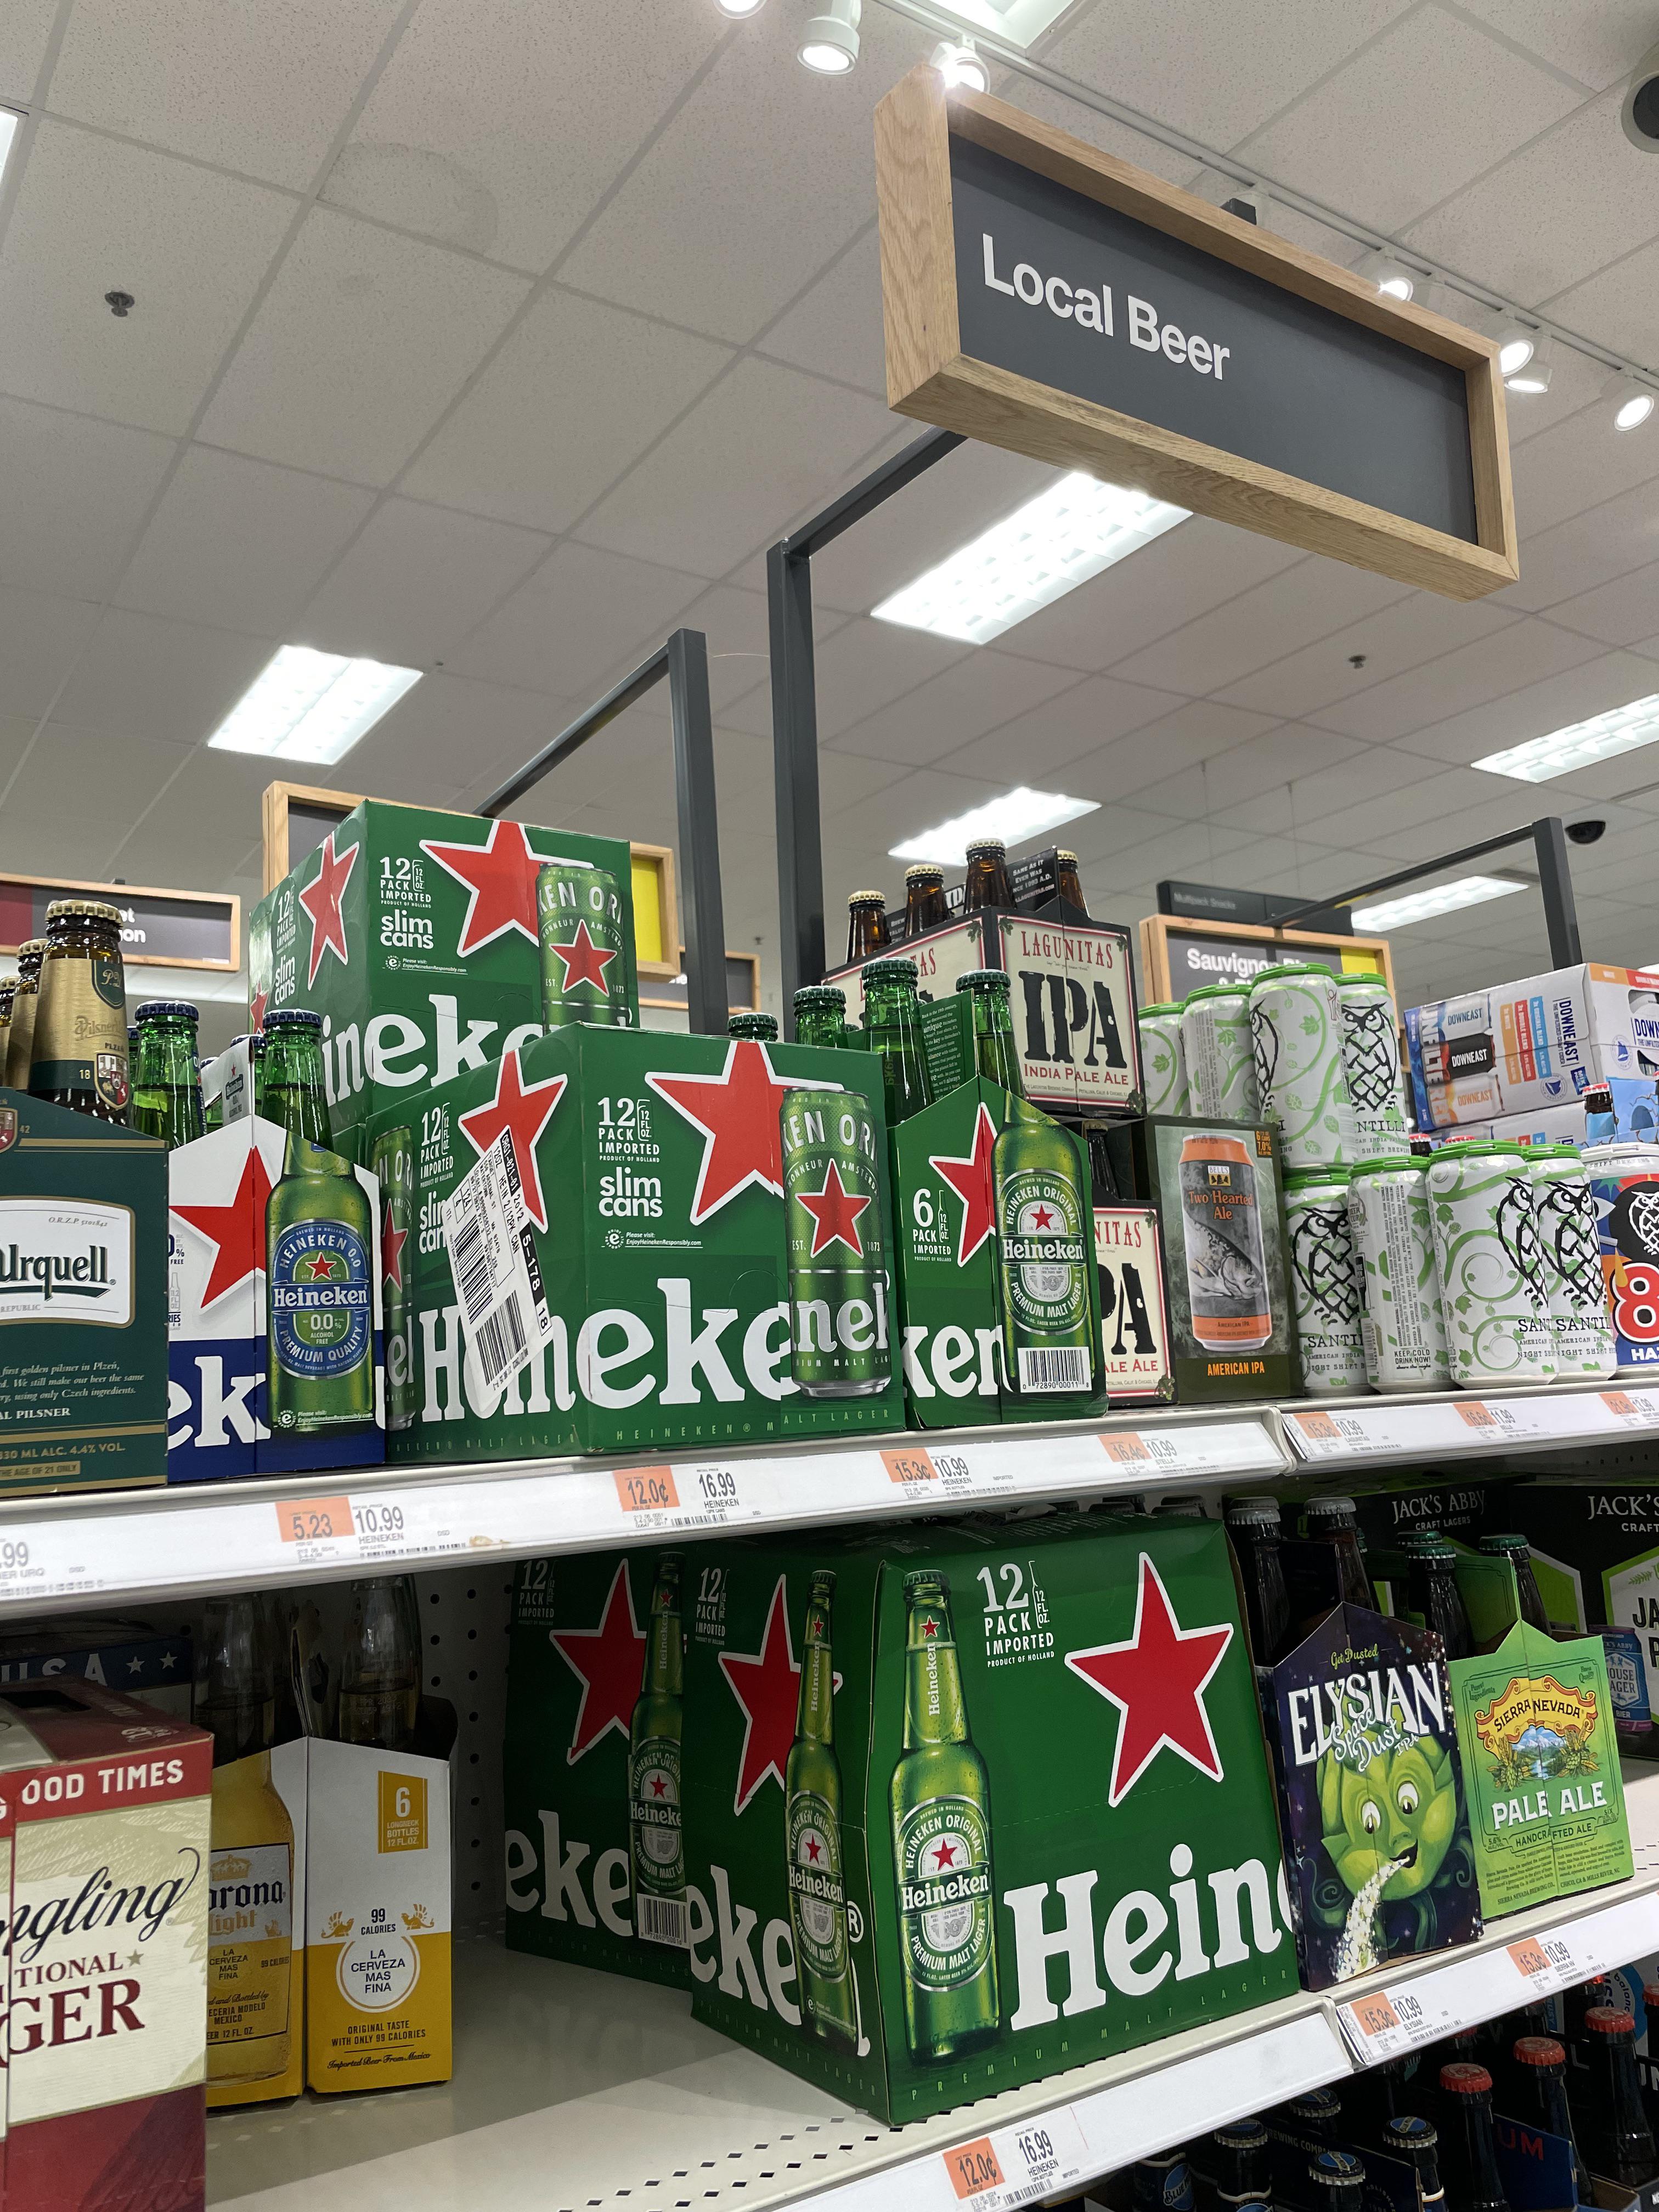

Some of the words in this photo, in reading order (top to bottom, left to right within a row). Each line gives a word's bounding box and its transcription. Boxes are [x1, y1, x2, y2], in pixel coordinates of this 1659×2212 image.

[983, 233, 1113, 336] Local
[1128, 295, 1230, 380] Beer
[380, 856, 411, 881] 12
[380, 879, 409, 890] PACK
[381, 890, 431, 902] IMPORTED
[381, 909, 432, 934] slim
[380, 932, 433, 949] cans
[1021, 931, 1113, 969] LAGUNITAS
[1019, 970, 1127, 1069] IPA
[1448, 1008, 1482, 1025] DOWNEAST
[1560, 1000, 1579, 1062] DOWNEAST
[1452, 1048, 1487, 1067] DOWNEAST
[1024, 1064, 1061, 1080] INDIA
[1065, 1067, 1099, 1084] PALE
[1104, 1071, 1128, 1086] ALE
[597, 1097, 636, 1127] 12
[599, 1127, 634, 1141] PACK
[599, 1142, 660, 1155] IMPORTED
[499, 1175, 509, 1199] HEIN
[600, 1166, 661, 1197] slim
[599, 1197, 663, 1217] cans
[913, 1188, 933, 1227] 6
[1006, 1186, 1040, 1224] HEINEKEN
[1044, 1186, 1077, 1226] ORIGINAL
[1189, 1191, 1209, 1204] Two
[1212, 1190, 1253, 1205] Hearted
[1214, 1206, 1233, 1220] Ale
[913, 1229, 936, 1243] PACK
[279, 1234, 347, 1268] HEINEKEN
[913, 1245, 951, 1256] IMPORTED
[1002, 1239, 1084, 1260] Heineken
[523, 1235, 540, 1291] 5-178
[538, 1307, 548, 1329] 18
[274, 1286, 368, 1307] Heineken
[1011, 1282, 1044, 1317] PREMIUM
[1047, 1302, 1068, 1317] MALT
[1068, 1282, 1082, 1310] LAGER
[310, 1313, 333, 1330] 0.0
[280, 1330, 323, 1362] PREMIUM
[328, 1326, 363, 1361] QUALITY
[1207, 1362, 1249, 1376] AMERICAN
[1251, 1361, 1265, 1374] IPA
[16, 1408, 71, 1419] PILSNER
[1146, 1440, 1178, 1457] 10.99
[935, 1457, 969, 1477] 10.99
[628, 1478, 668, 1508] 12.0¢
[699, 1472, 736, 1498] 16.99
[943, 1477, 972, 1486] HEINEKEN
[704, 1498, 740, 1509] HEINEKEN
[1392, 1492, 1442, 1523] JACK'S
[1449, 1490, 1486, 1511] ABBY
[293, 1514, 332, 1539] 5.23
[355, 1506, 404, 1533] 10.99
[1415, 1520, 1440, 1531] CRAFT
[1443, 1516, 1471, 1527] LAGERS
[358, 1533, 404, 1544] HEINEKEN
[977, 1563, 1029, 1612] 12
[985, 1612, 1031, 1637] PACK
[986, 1632, 1053, 1656] IMPORTED
[1331, 1651, 1344, 1669] Get
[1345, 1643, 1379, 1663] Dusted
[988, 1657, 1015, 1668] PRODUCT
[1028, 1651, 1054, 1661] HOLLAND
[928, 1641, 940, 1716] Heineken
[1288, 1662, 1446, 1766] ELYSIAN
[1494, 1699, 1531, 1733] SIERRA
[1533, 1698, 1581, 1719] NEVADA
[1331, 1708, 1376, 1761] Space
[1353, 1718, 1401, 1773] Dust
[98, 1758, 184, 1795] TIMES
[395, 1787, 411, 1818] 6
[1492, 1790, 1552, 1830] PALE
[1560, 1781, 1607, 1815] ALE
[386, 1828, 420, 1838] BOTTLES
[906, 1816, 942, 1869] HEINEKEN
[946, 1814, 982, 1855] ORIGINAL
[1516, 1827, 1574, 1847] HANDCRAFTED
[1576, 1823, 1592, 1833] ALE
[788, 1865, 843, 1903] Heineken
[901, 1874, 989, 1911] Heineken
[371, 1908, 386, 1923] 99
[360, 1923, 396, 1935] CALORIES
[1004, 1843, 1294, 2031] Hein
[370, 1949, 386, 1960] LA
[911, 1935, 946, 1971] PREMIUM
[949, 1947, 971, 1970] MALT
[969, 1918, 986, 1954] LAGER
[209, 1955, 249, 1965] CERVEZA
[351, 1959, 405, 1972] CERVEZA
[364, 1982, 391, 1994] FINA
[365, 1971, 391, 1982] MAS
[214, 2014, 242, 2025] MEXICO
[238, 2002, 266, 2013] MODELO
[1393, 1995, 1424, 2022] 10.99
[347, 2022, 385, 2035] ORIGINAL
[387, 2019, 410, 2030] TASTE
[960, 2151, 997, 2187] 12.0¢
[1019, 2130, 1054, 2164] 16.99
[1027, 2158, 1059, 2178] HEINEKEN
